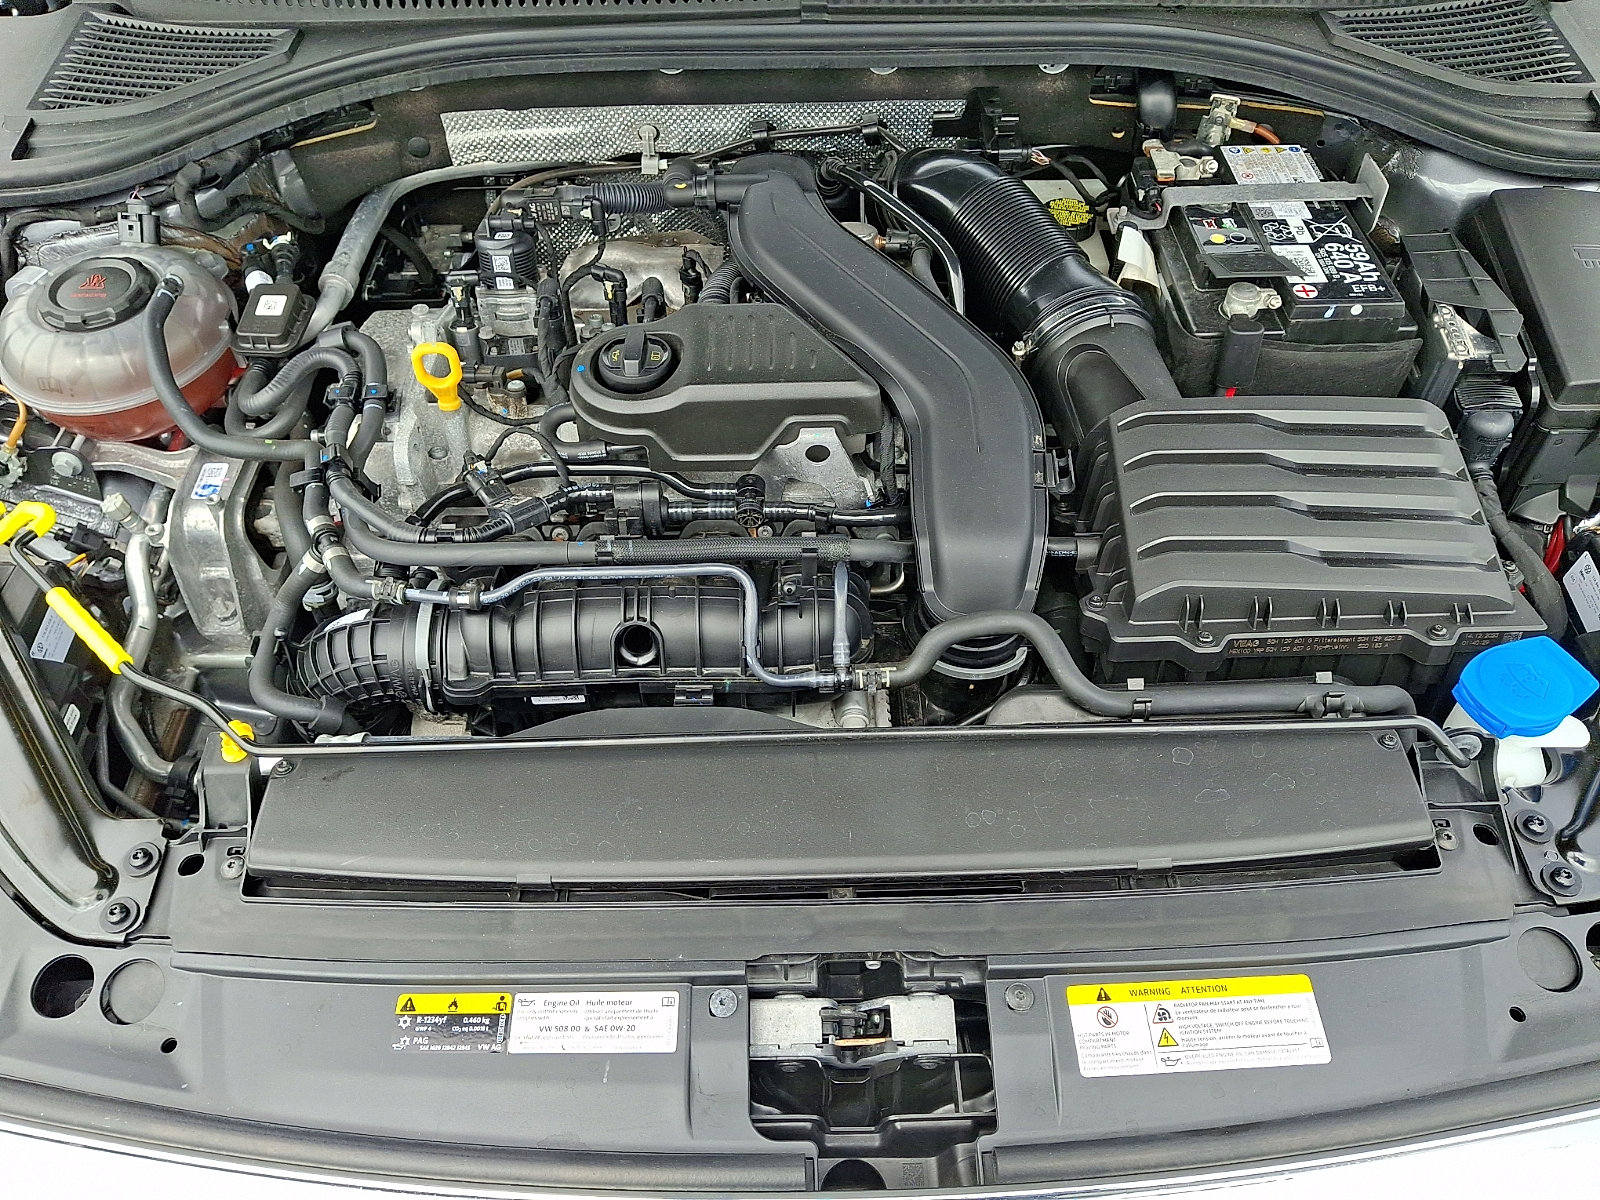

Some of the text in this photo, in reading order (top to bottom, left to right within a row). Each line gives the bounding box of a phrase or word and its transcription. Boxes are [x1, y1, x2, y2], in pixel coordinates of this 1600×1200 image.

[1294, 225, 1305, 235] Pb
[1324, 242, 1354, 269] 640
[1339, 271, 1362, 284] A
[1344, 243, 1381, 282] 59Ah
[1351, 284, 1386, 293] EFB+
[1128, 984, 1228, 997] WARNING ATTENTION
[543, 999, 568, 1008] Engine
[569, 999, 580, 1007] Oil
[586, 998, 604, 1006] Huile
[416, 1015, 448, 1025] R-1234yf
[482, 1016, 491, 1025] kg
[539, 1025, 552, 1033] VW
[594, 1024, 608, 1032] SAE
[610, 1024, 636, 1032] 0W-20
[413, 1036, 429, 1045] PAG
